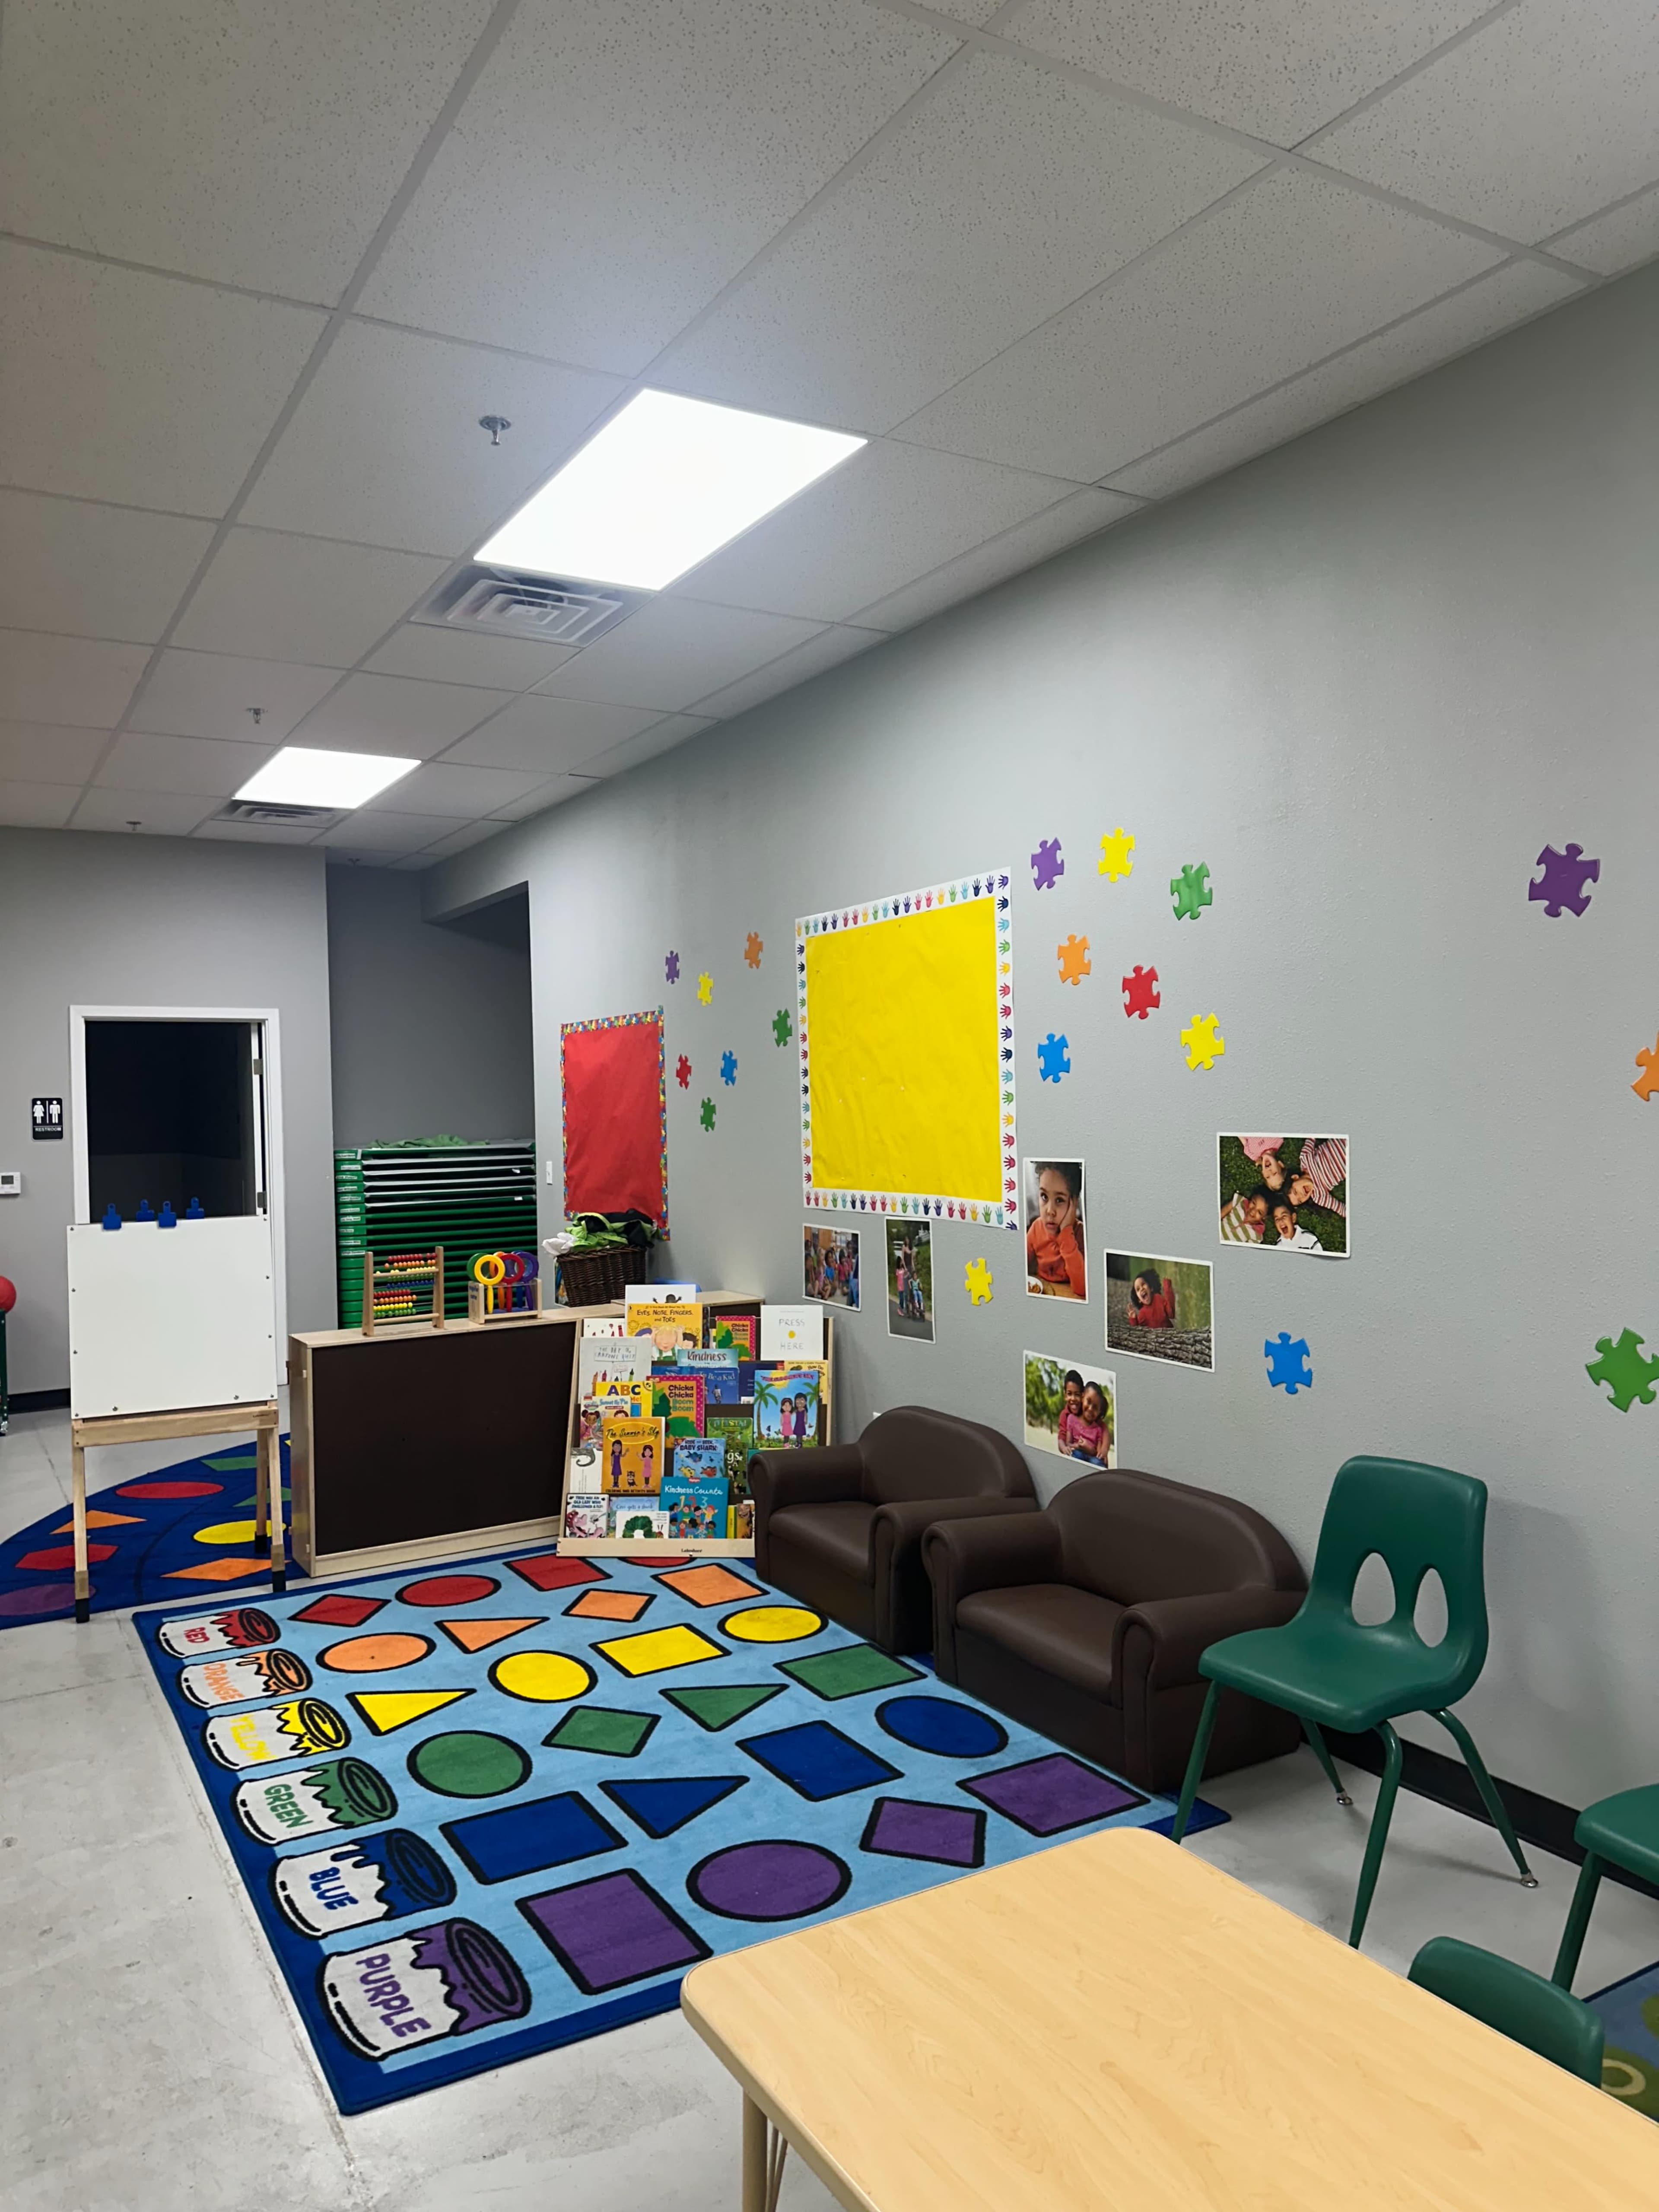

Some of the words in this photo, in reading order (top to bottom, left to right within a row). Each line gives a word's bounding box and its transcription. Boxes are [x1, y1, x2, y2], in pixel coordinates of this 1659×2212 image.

[688, 1351, 727, 1361] Kindness
[607, 1384, 641, 1396] ABC
[607, 1429, 616, 1438] The
[665, 1485, 693, 1494] Kindness
[694, 1487, 723, 1495] Counts
[700, 1496, 708, 1508] 3
[184, 1627, 210, 1643] RED
[203, 1662, 245, 1701] ORANGE
[230, 1714, 276, 1761] YELLOW
[264, 1783, 314, 1828] GREEN
[309, 1866, 359, 1910] BLUE
[356, 1953, 432, 2037] PURPLE
